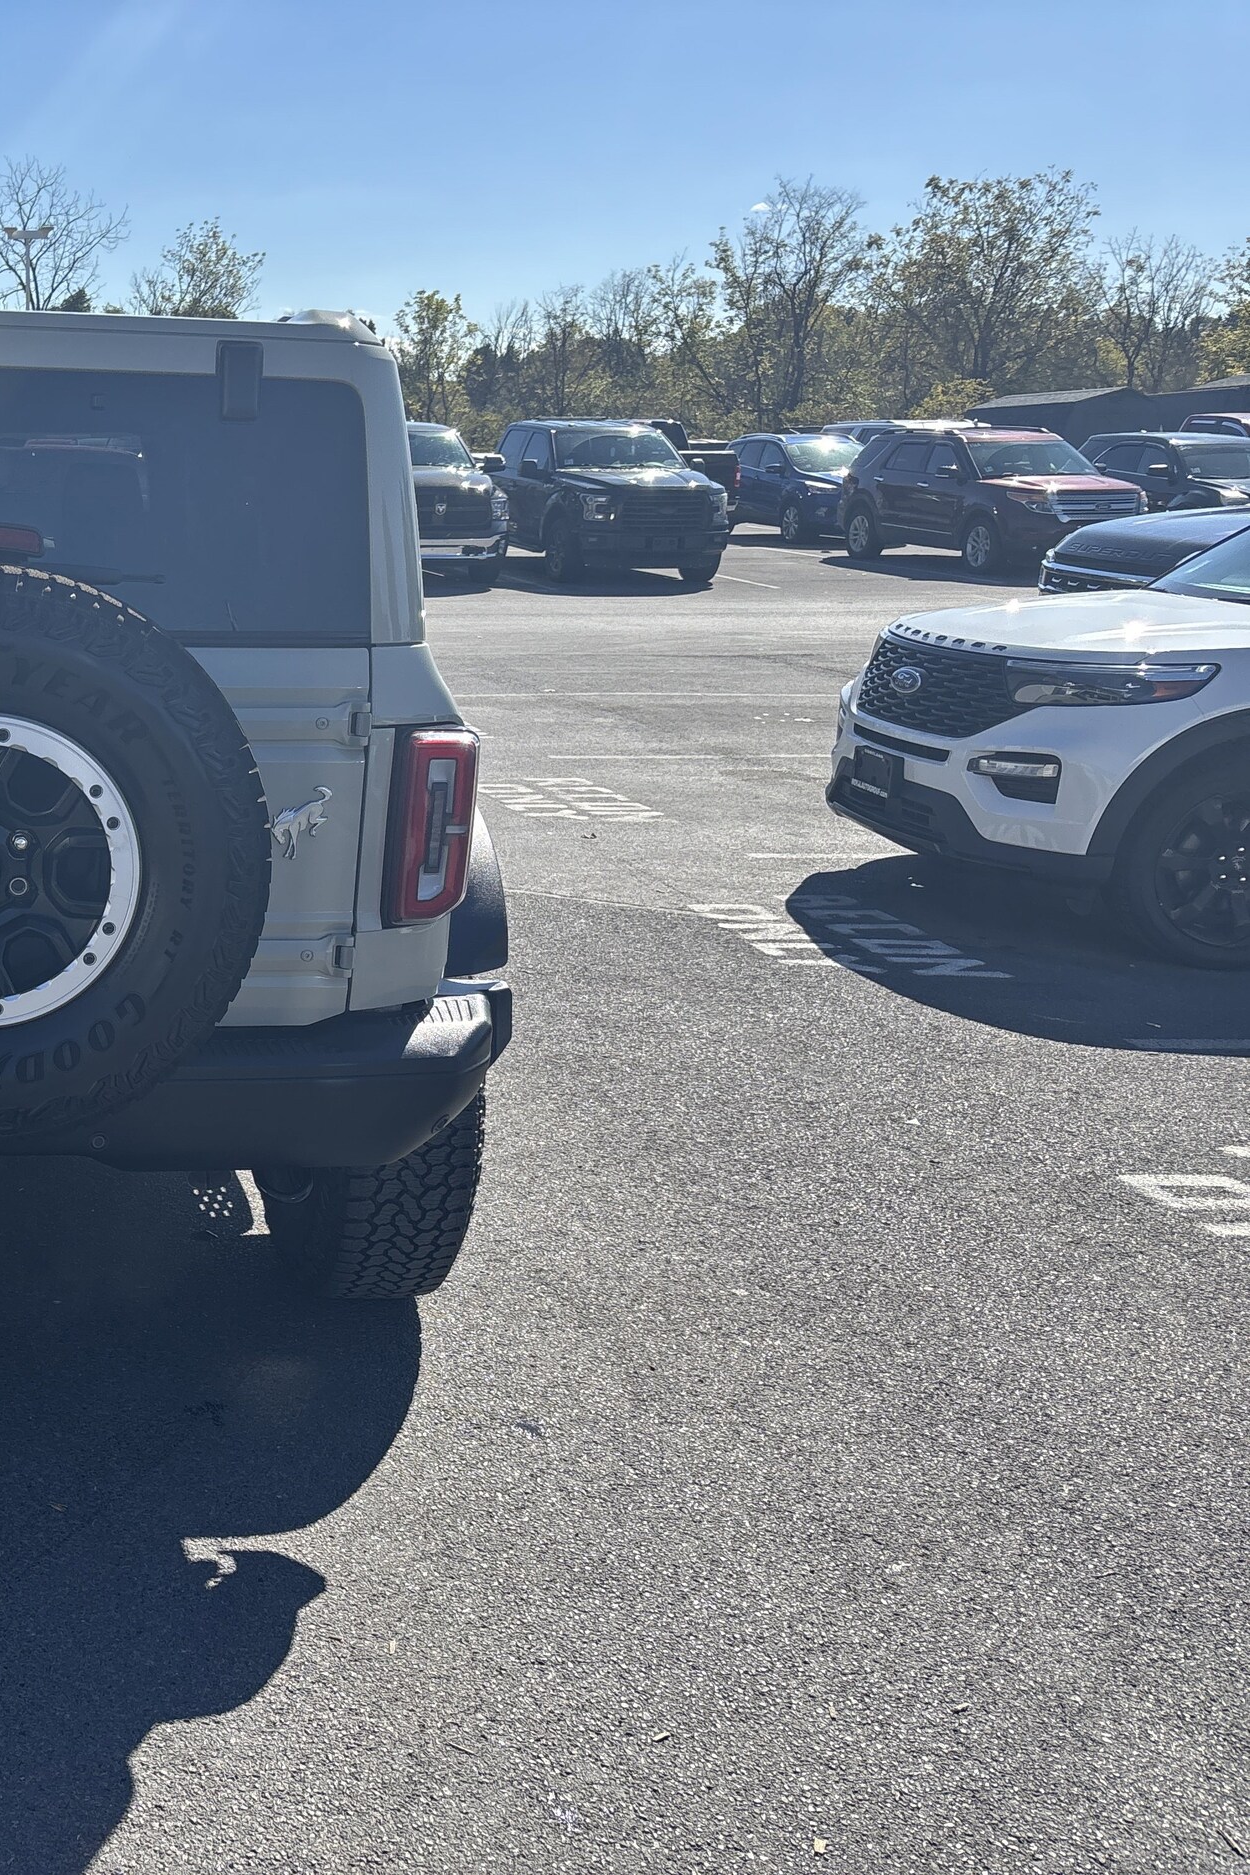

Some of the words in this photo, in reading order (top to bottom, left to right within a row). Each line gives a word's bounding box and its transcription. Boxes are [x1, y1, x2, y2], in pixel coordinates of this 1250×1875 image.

[1067, 541, 1123, 559] SUPER
[161, 776, 196, 911] TERRITORY
[163, 928, 184, 964] RT
[686, 903, 889, 974] ONLY
